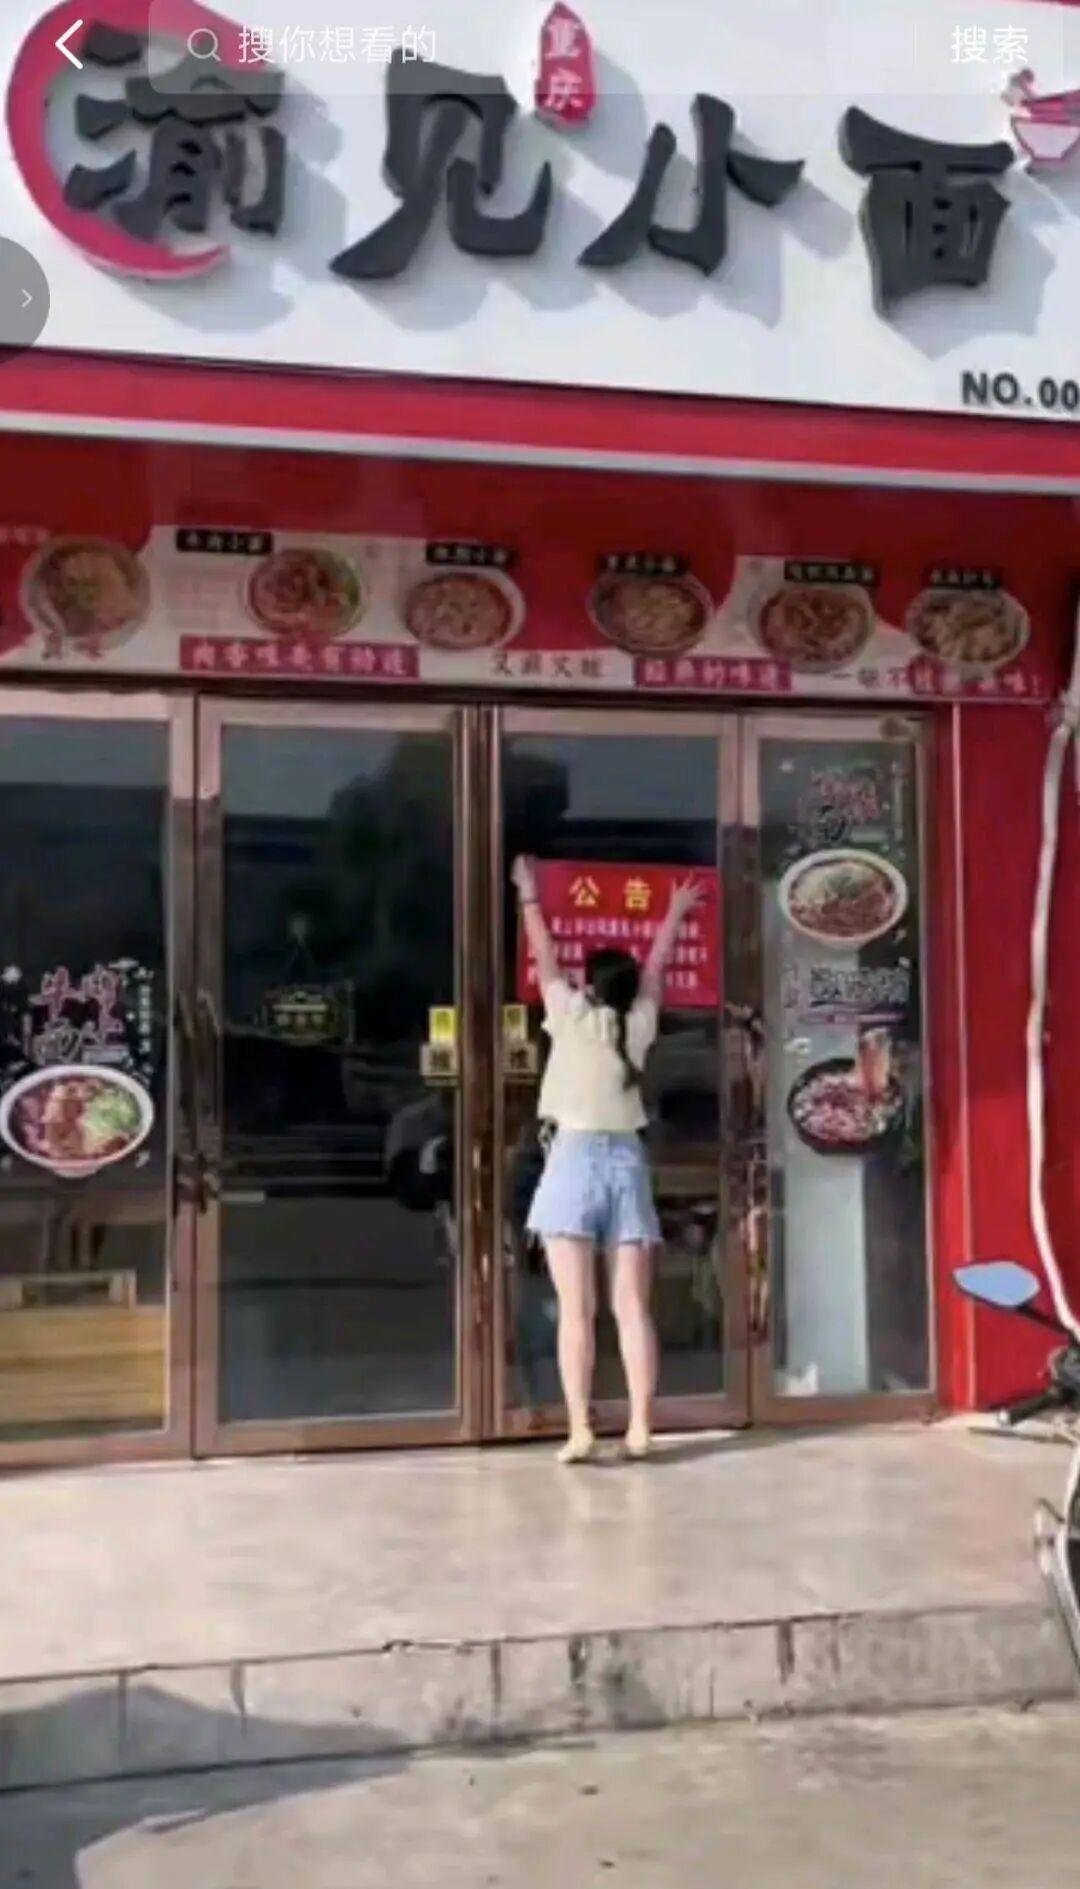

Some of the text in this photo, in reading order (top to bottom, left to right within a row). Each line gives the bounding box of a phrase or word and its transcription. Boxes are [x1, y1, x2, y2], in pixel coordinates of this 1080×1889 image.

[544, 17, 584, 112] 重庆
[63, 20, 1014, 318] 渝见小面
[961, 371, 1079, 411] NO.00
[568, 875, 652, 911] 公告
